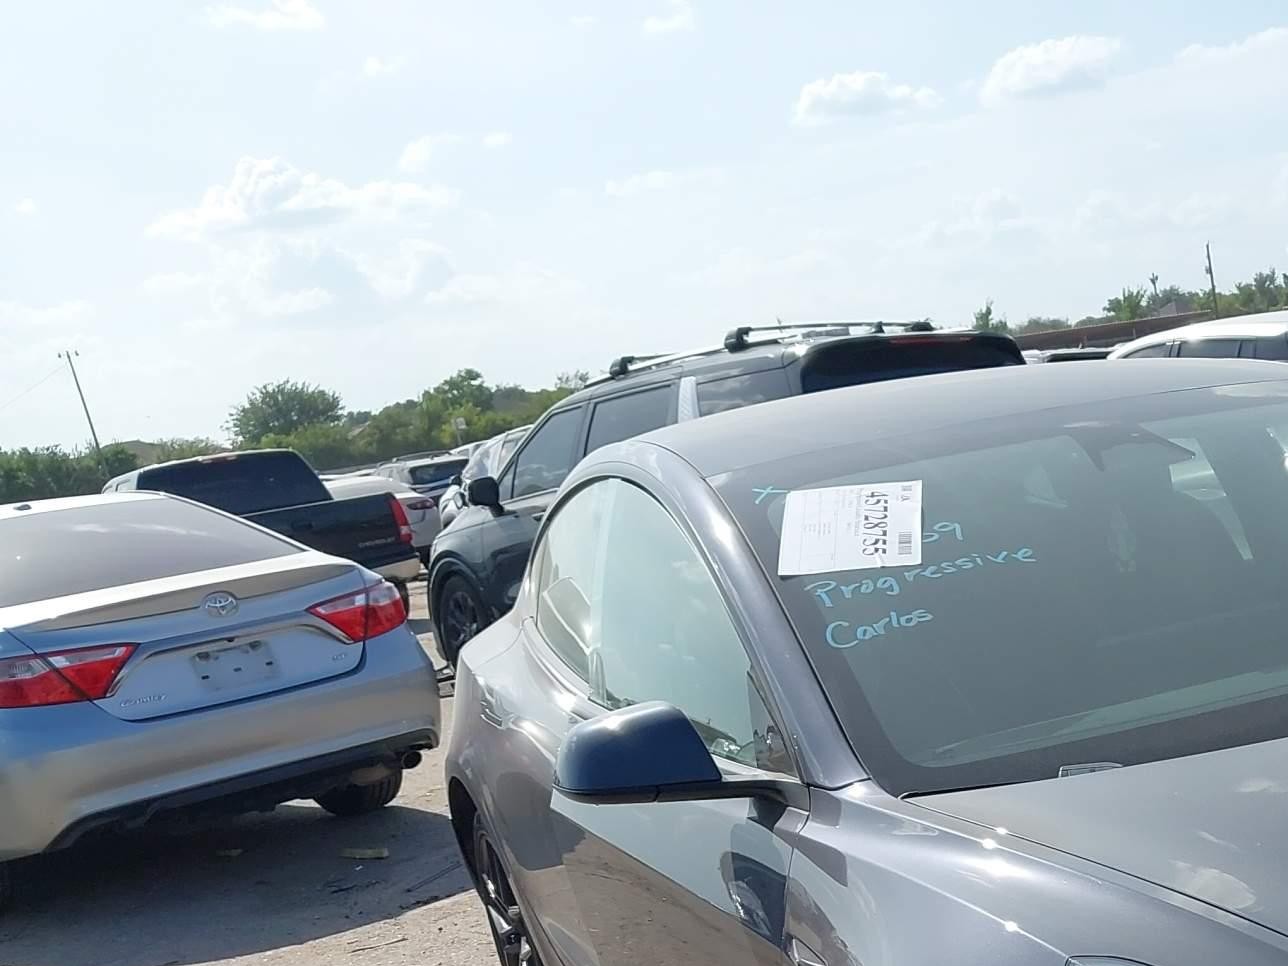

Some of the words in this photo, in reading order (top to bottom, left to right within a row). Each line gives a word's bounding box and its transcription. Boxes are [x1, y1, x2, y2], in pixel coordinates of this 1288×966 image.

[862, 490, 889, 557] 45728755
[804, 547, 1037, 608] Progressive
[826, 609, 934, 648] Carlos
